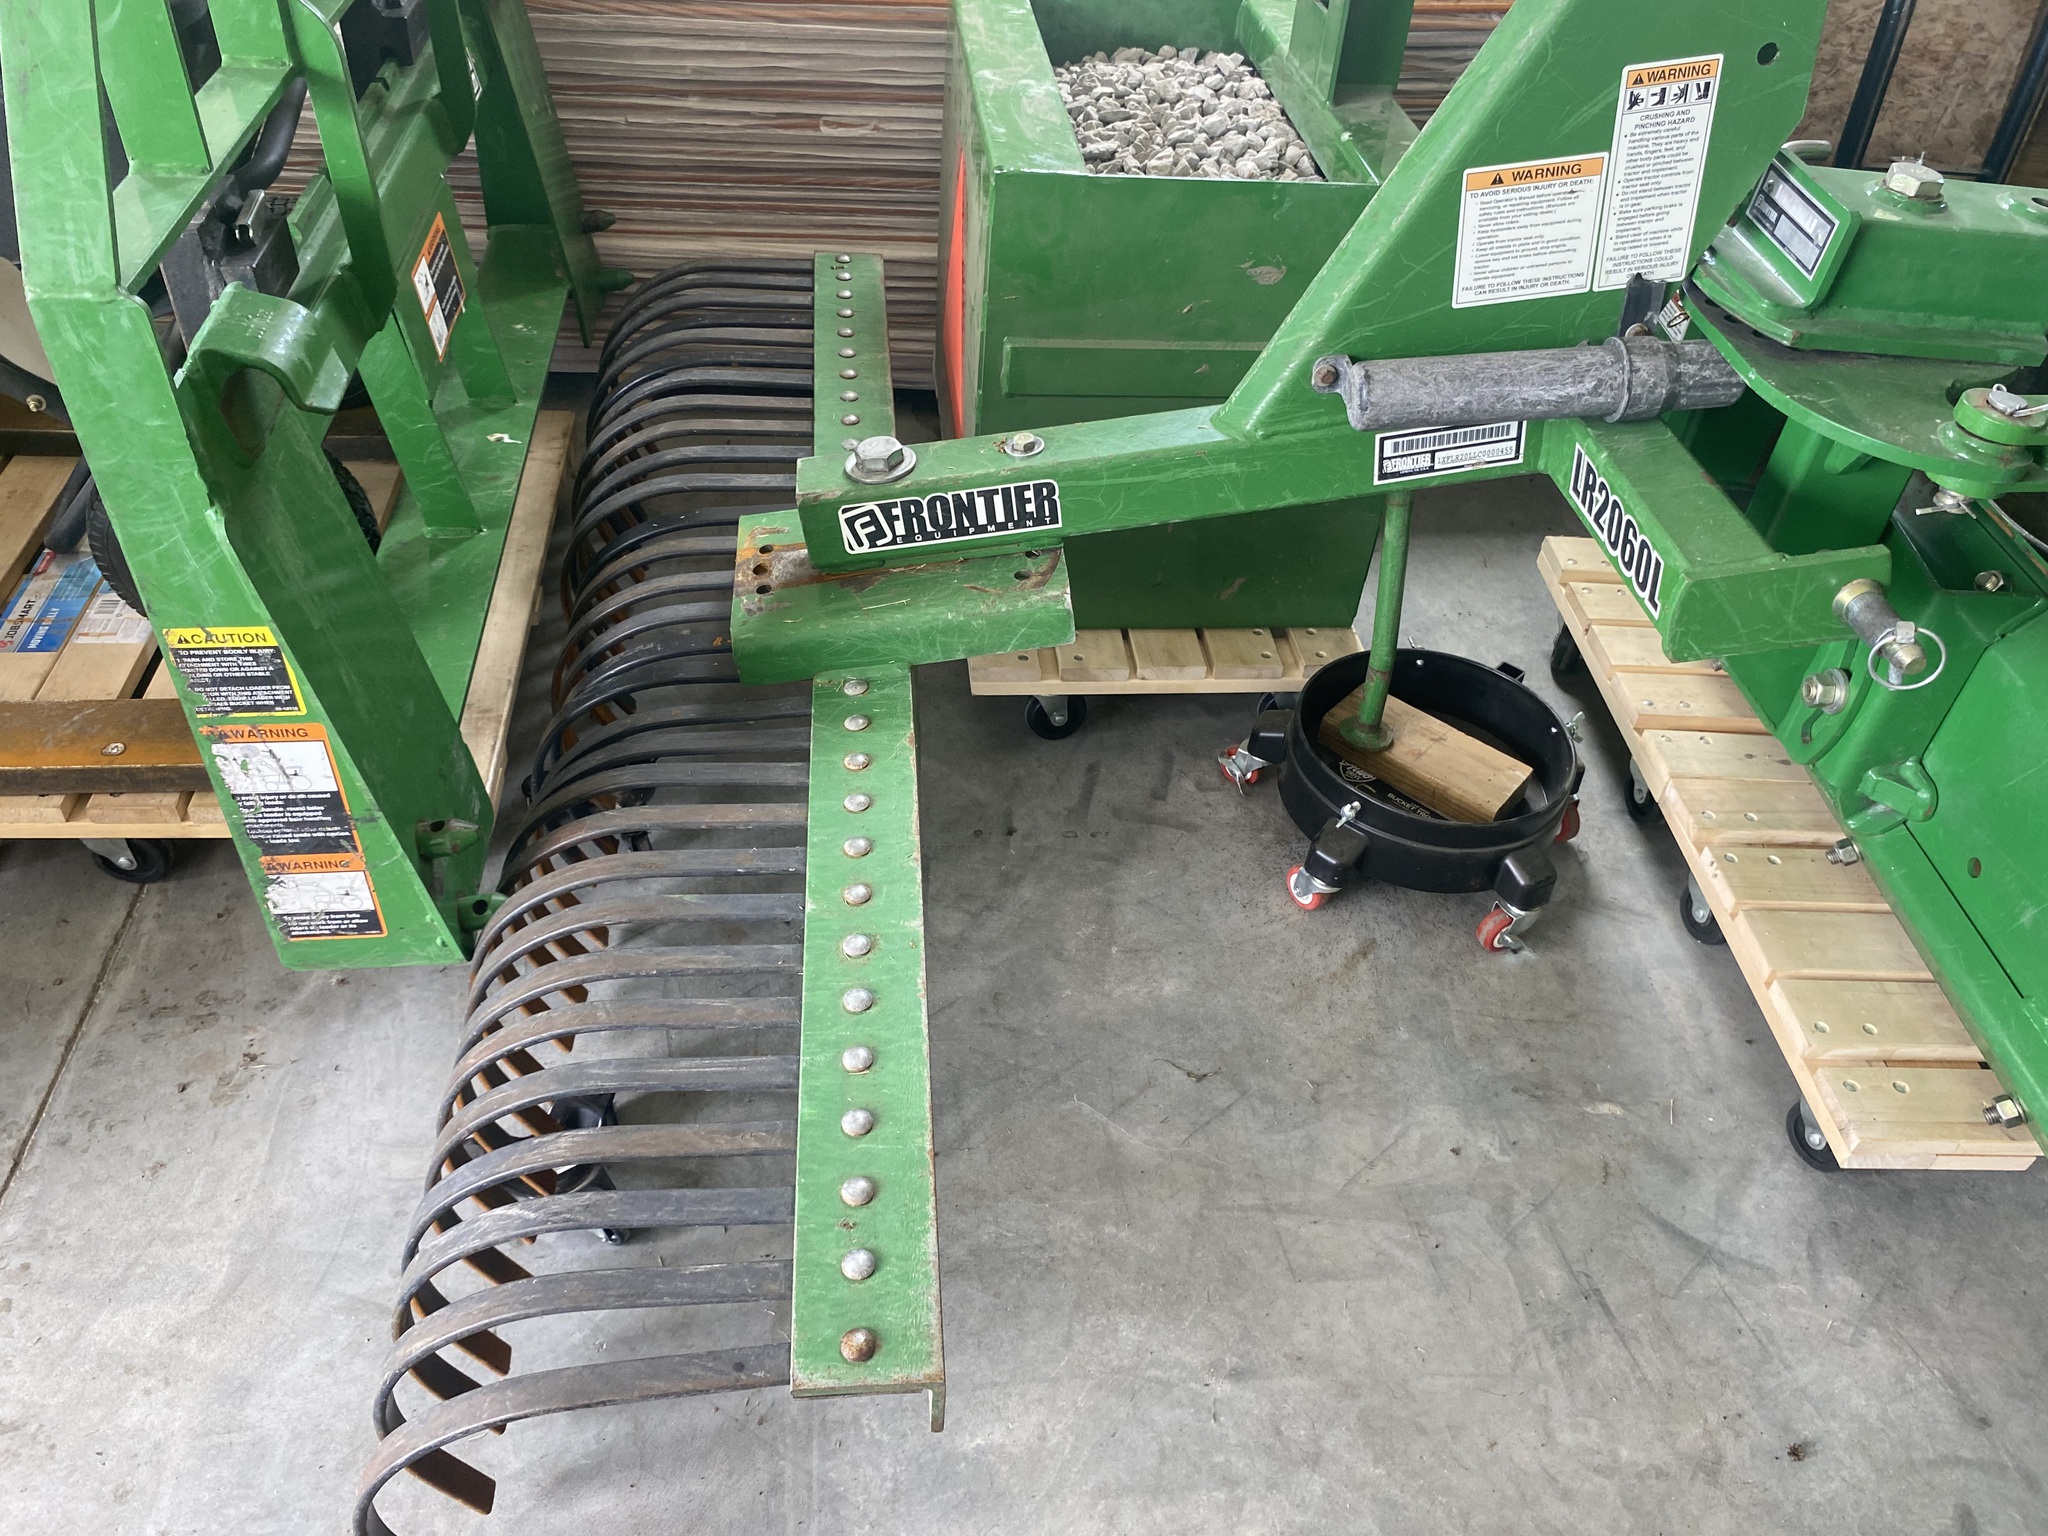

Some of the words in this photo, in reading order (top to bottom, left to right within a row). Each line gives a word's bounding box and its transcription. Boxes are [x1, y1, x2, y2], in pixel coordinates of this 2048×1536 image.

[1646, 63, 1711, 83] WARNING
[1634, 121, 1665, 129] PINCHING
[1668, 117, 1695, 125] HAZARD
[1639, 111, 1674, 121] CRUSHING
[1675, 108, 1690, 116] AND
[1628, 136, 1650, 144] handling
[1638, 128, 1661, 136] extremely
[1511, 163, 1582, 181] WARNING
[1480, 189, 1500, 197] AVOID
[1502, 186, 1531, 194] SERIOUS
[1569, 178, 1594, 186] DEATH:
[1613, 258, 1652, 267] INSTRUCTIONS
[1542, 272, 1584, 282] INSTRUCTIONS
[1392, 452, 1432, 470] FRONTIER
[884, 482, 1058, 536] FRONTIER
[897, 517, 1052, 544] EQUIPMENT
[1572, 448, 1662, 612] LR2060L
[4, 600, 36, 639] JOBSMART
[27, 626, 49, 648] MOVING
[191, 633, 267, 644] CAUTION
[230, 728, 309, 739] WARNING
[1387, 792, 1416, 811] BUCKET
[1416, 807, 1432, 819] TRO
[277, 860, 350, 870] WARNING
